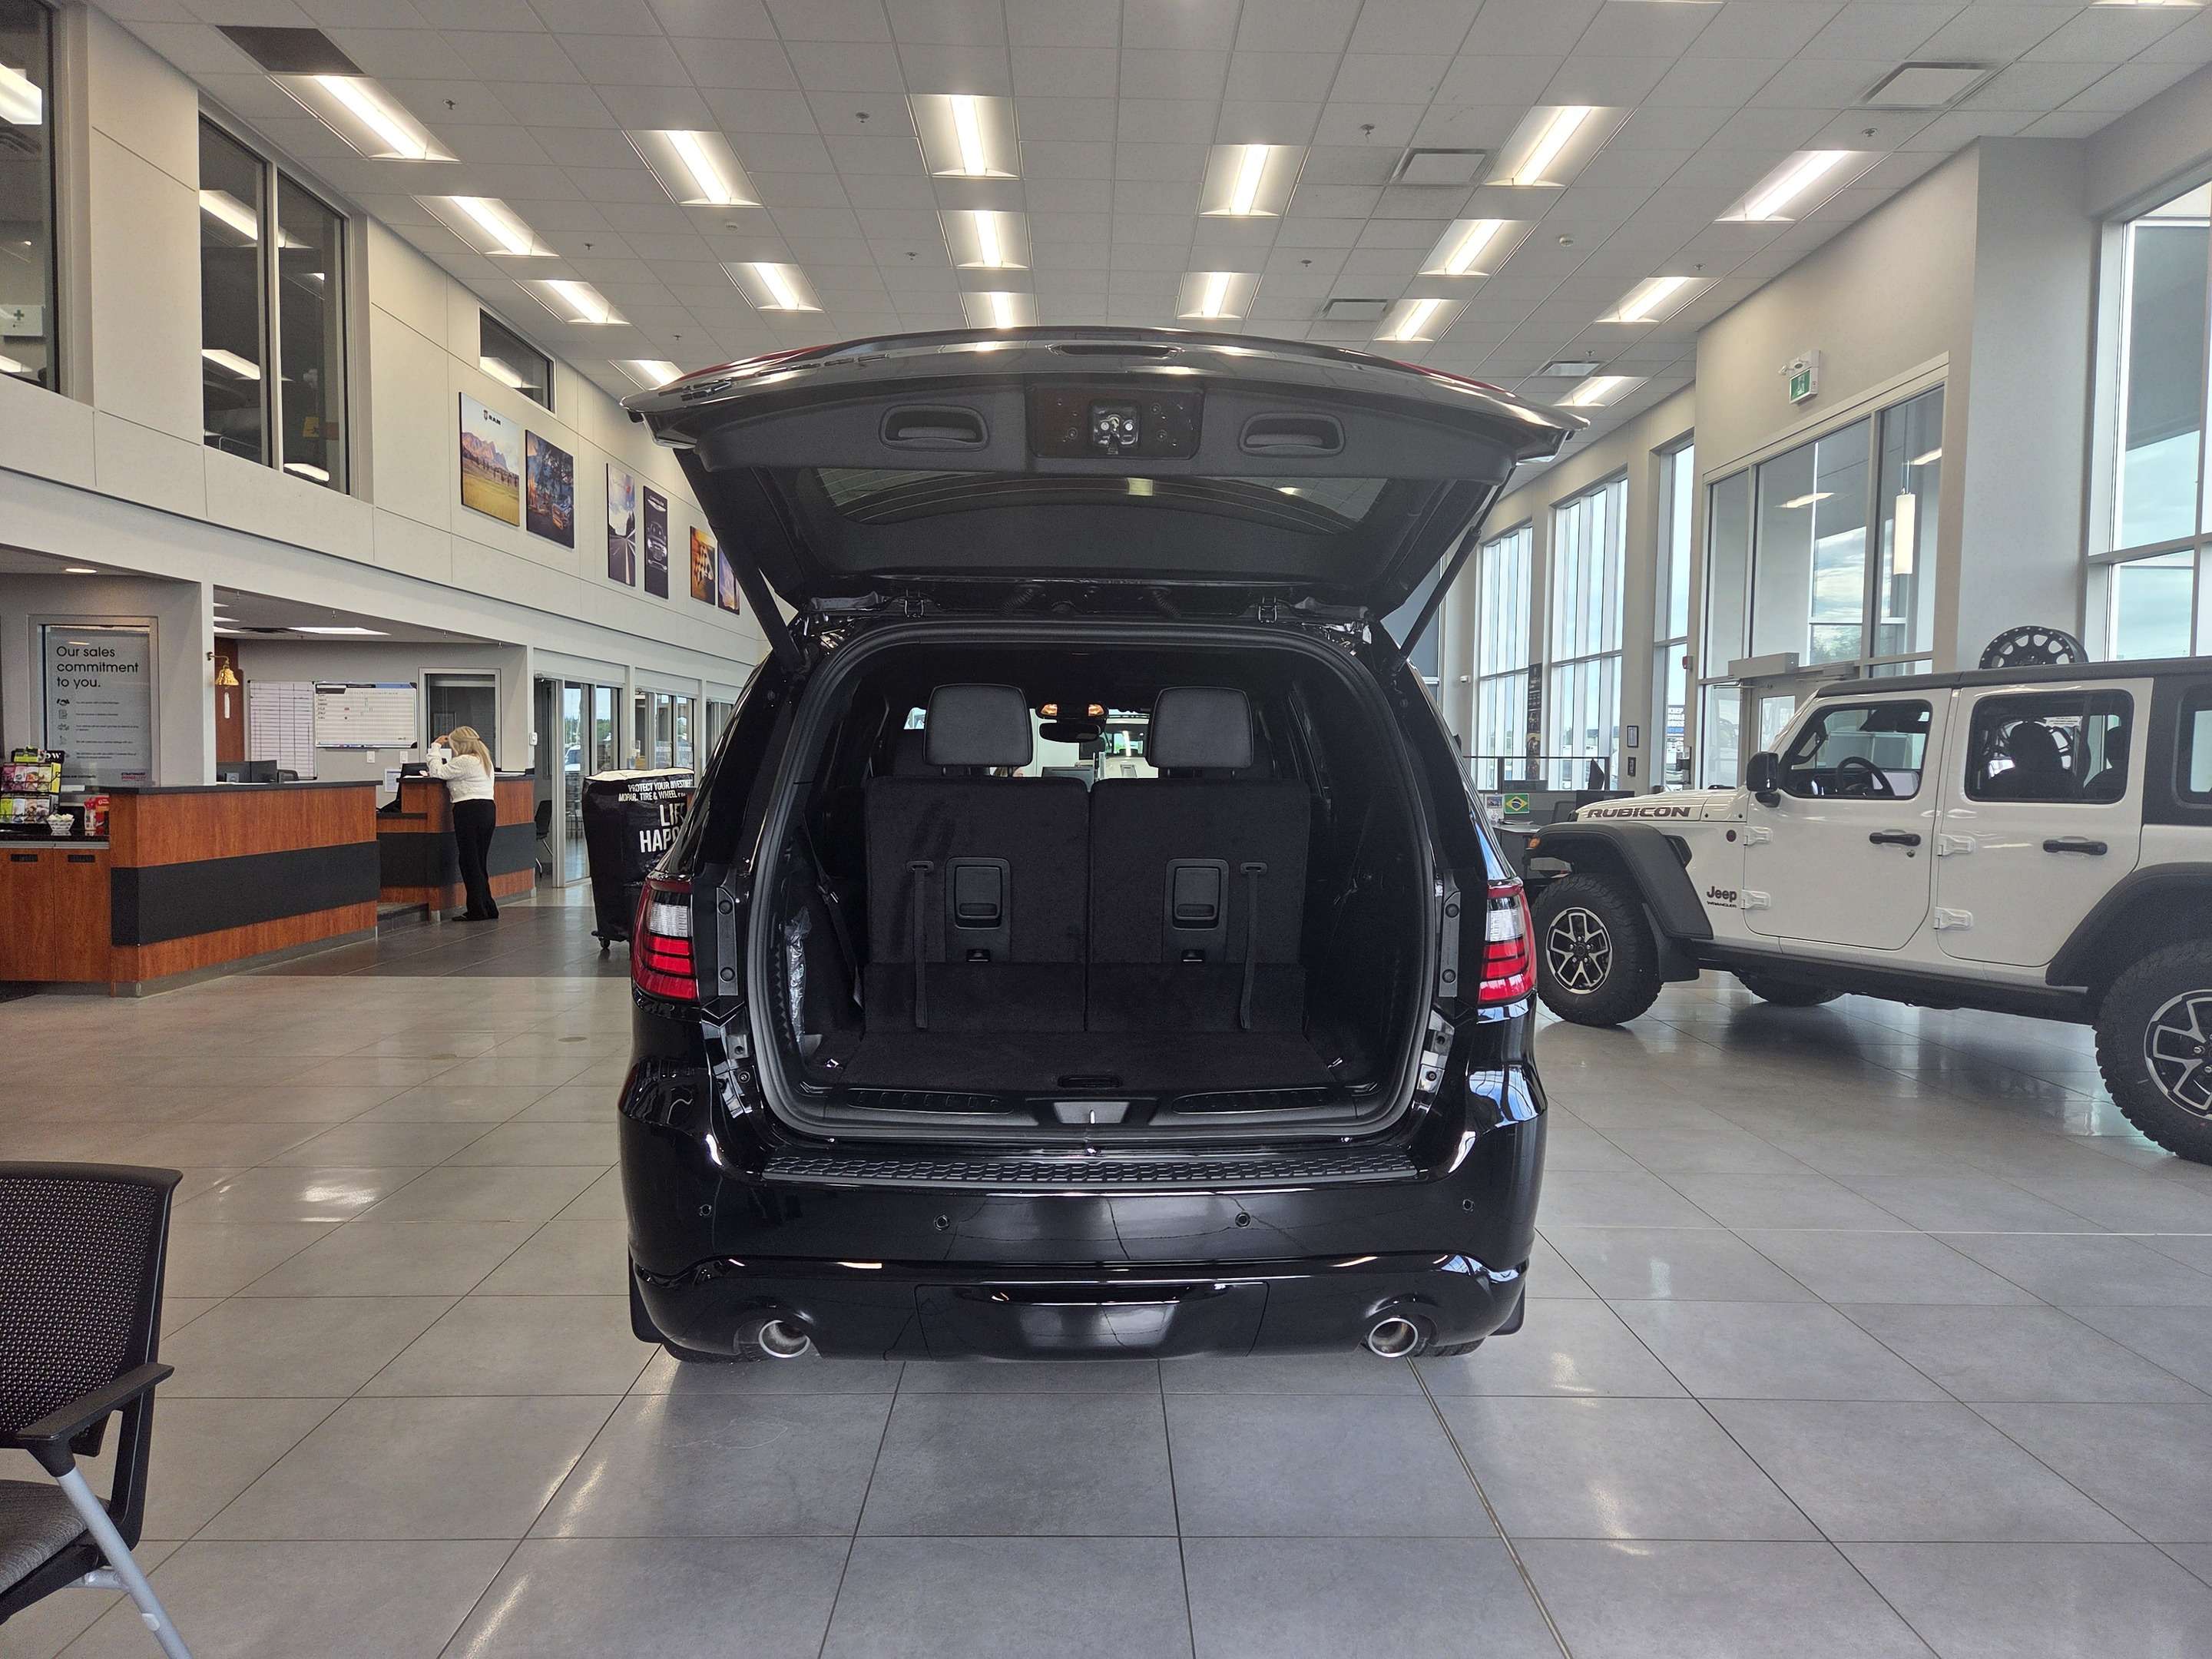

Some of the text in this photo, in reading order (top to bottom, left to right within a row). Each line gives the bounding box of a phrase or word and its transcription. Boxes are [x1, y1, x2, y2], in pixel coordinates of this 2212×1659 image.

[56, 646, 115, 657] Our sales
[57, 662, 139, 673] commitment
[57, 677, 101, 690] to you.
[628, 783, 653, 793] PROTECT
[654, 781, 670, 791] YOUR
[639, 792, 653, 801] TIRE
[653, 791, 658, 800] &
[658, 790, 678, 800] WHEEL
[1585, 806, 1691, 819] RUBICON
[1706, 886, 1737, 903] Jeep
